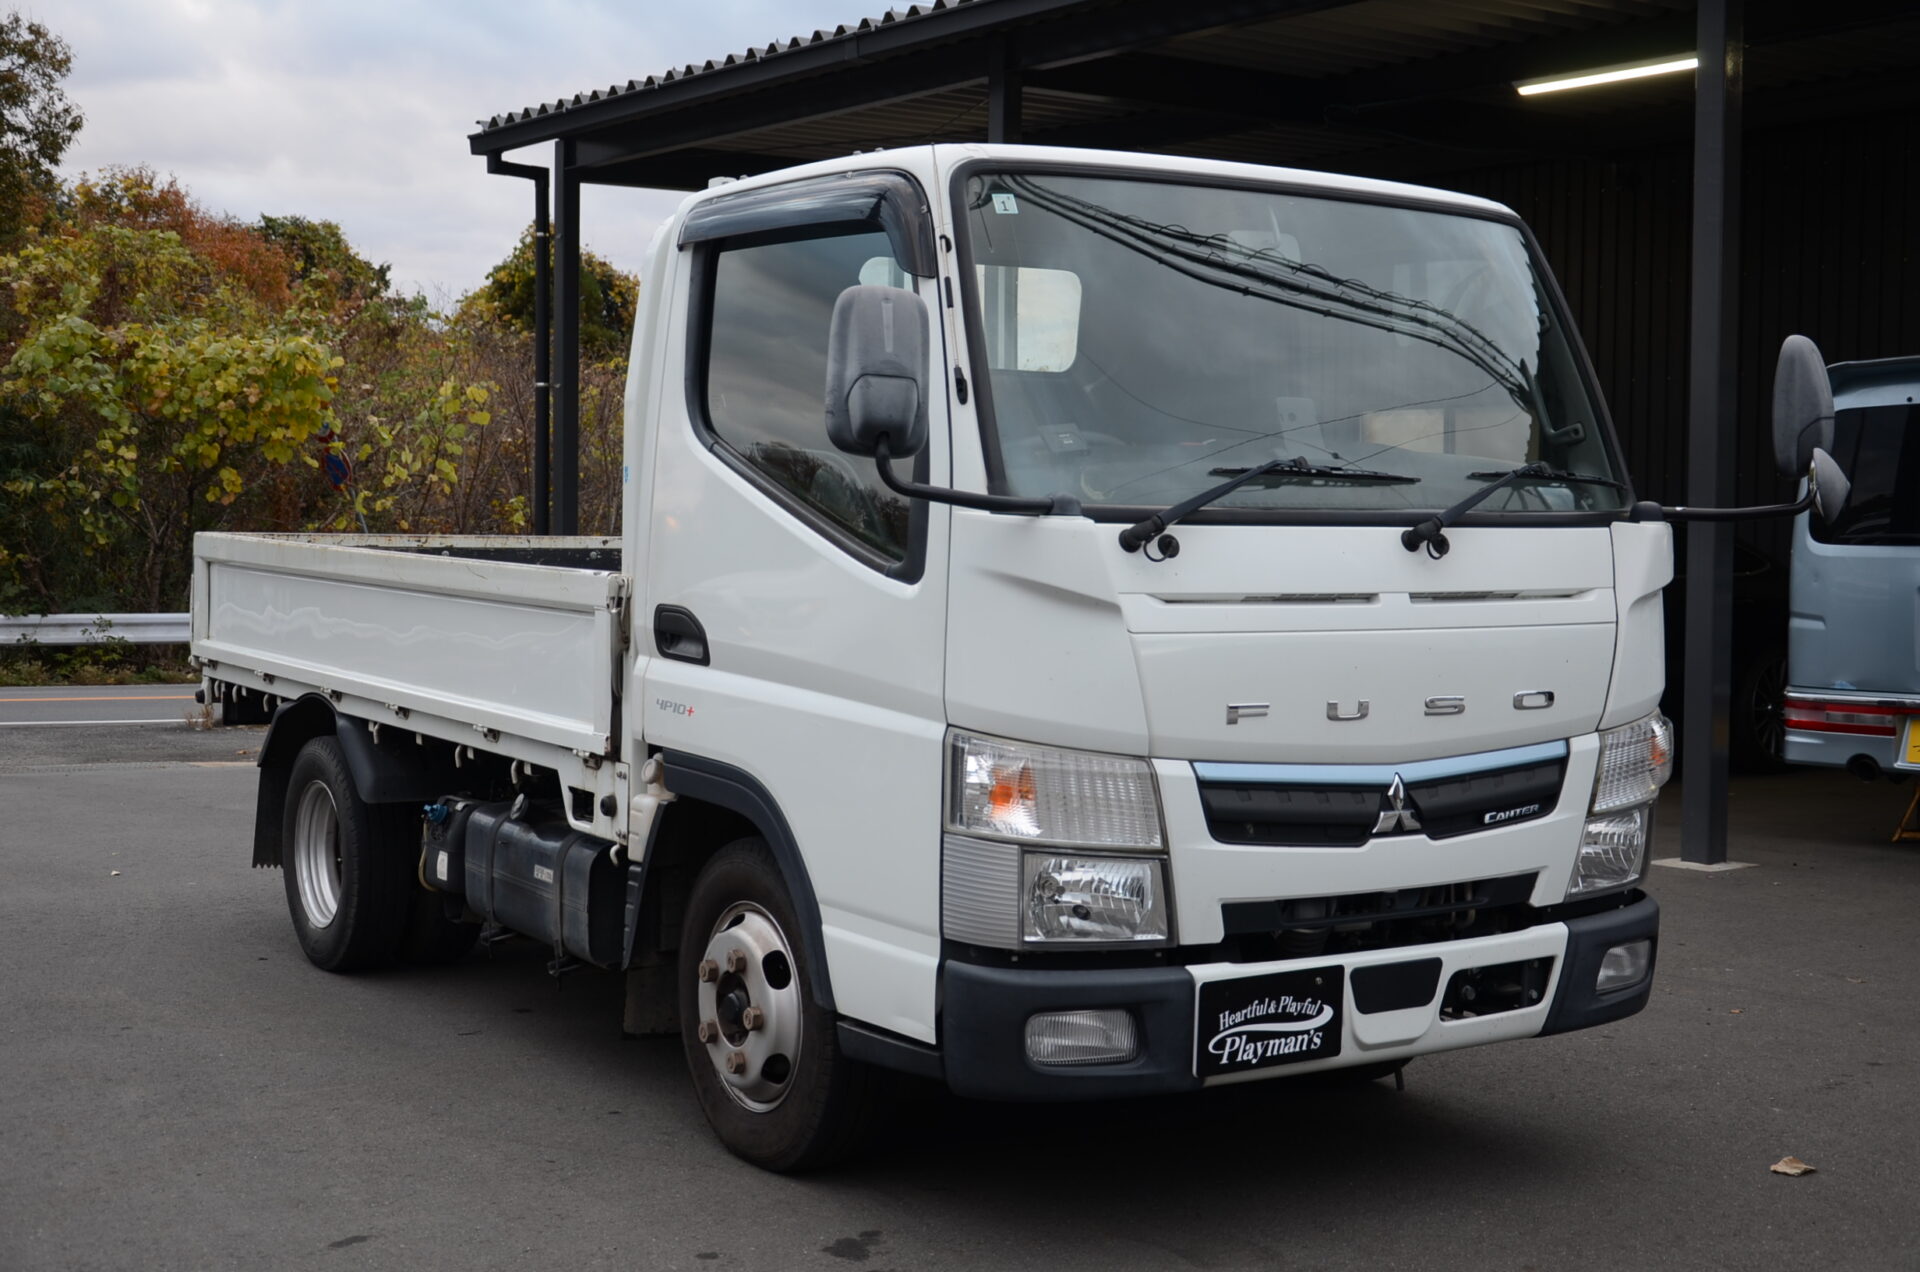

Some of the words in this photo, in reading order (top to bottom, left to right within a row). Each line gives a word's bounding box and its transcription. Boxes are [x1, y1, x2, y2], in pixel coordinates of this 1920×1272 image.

[1226, 690, 1555, 725] FUSO
[1484, 804, 1539, 824] CANTER
[1218, 998, 1268, 1031] Heartful
[1269, 1000, 1277, 1014] &
[1278, 996, 1321, 1015] Playful
[1219, 1029, 1323, 1065] Playman's
